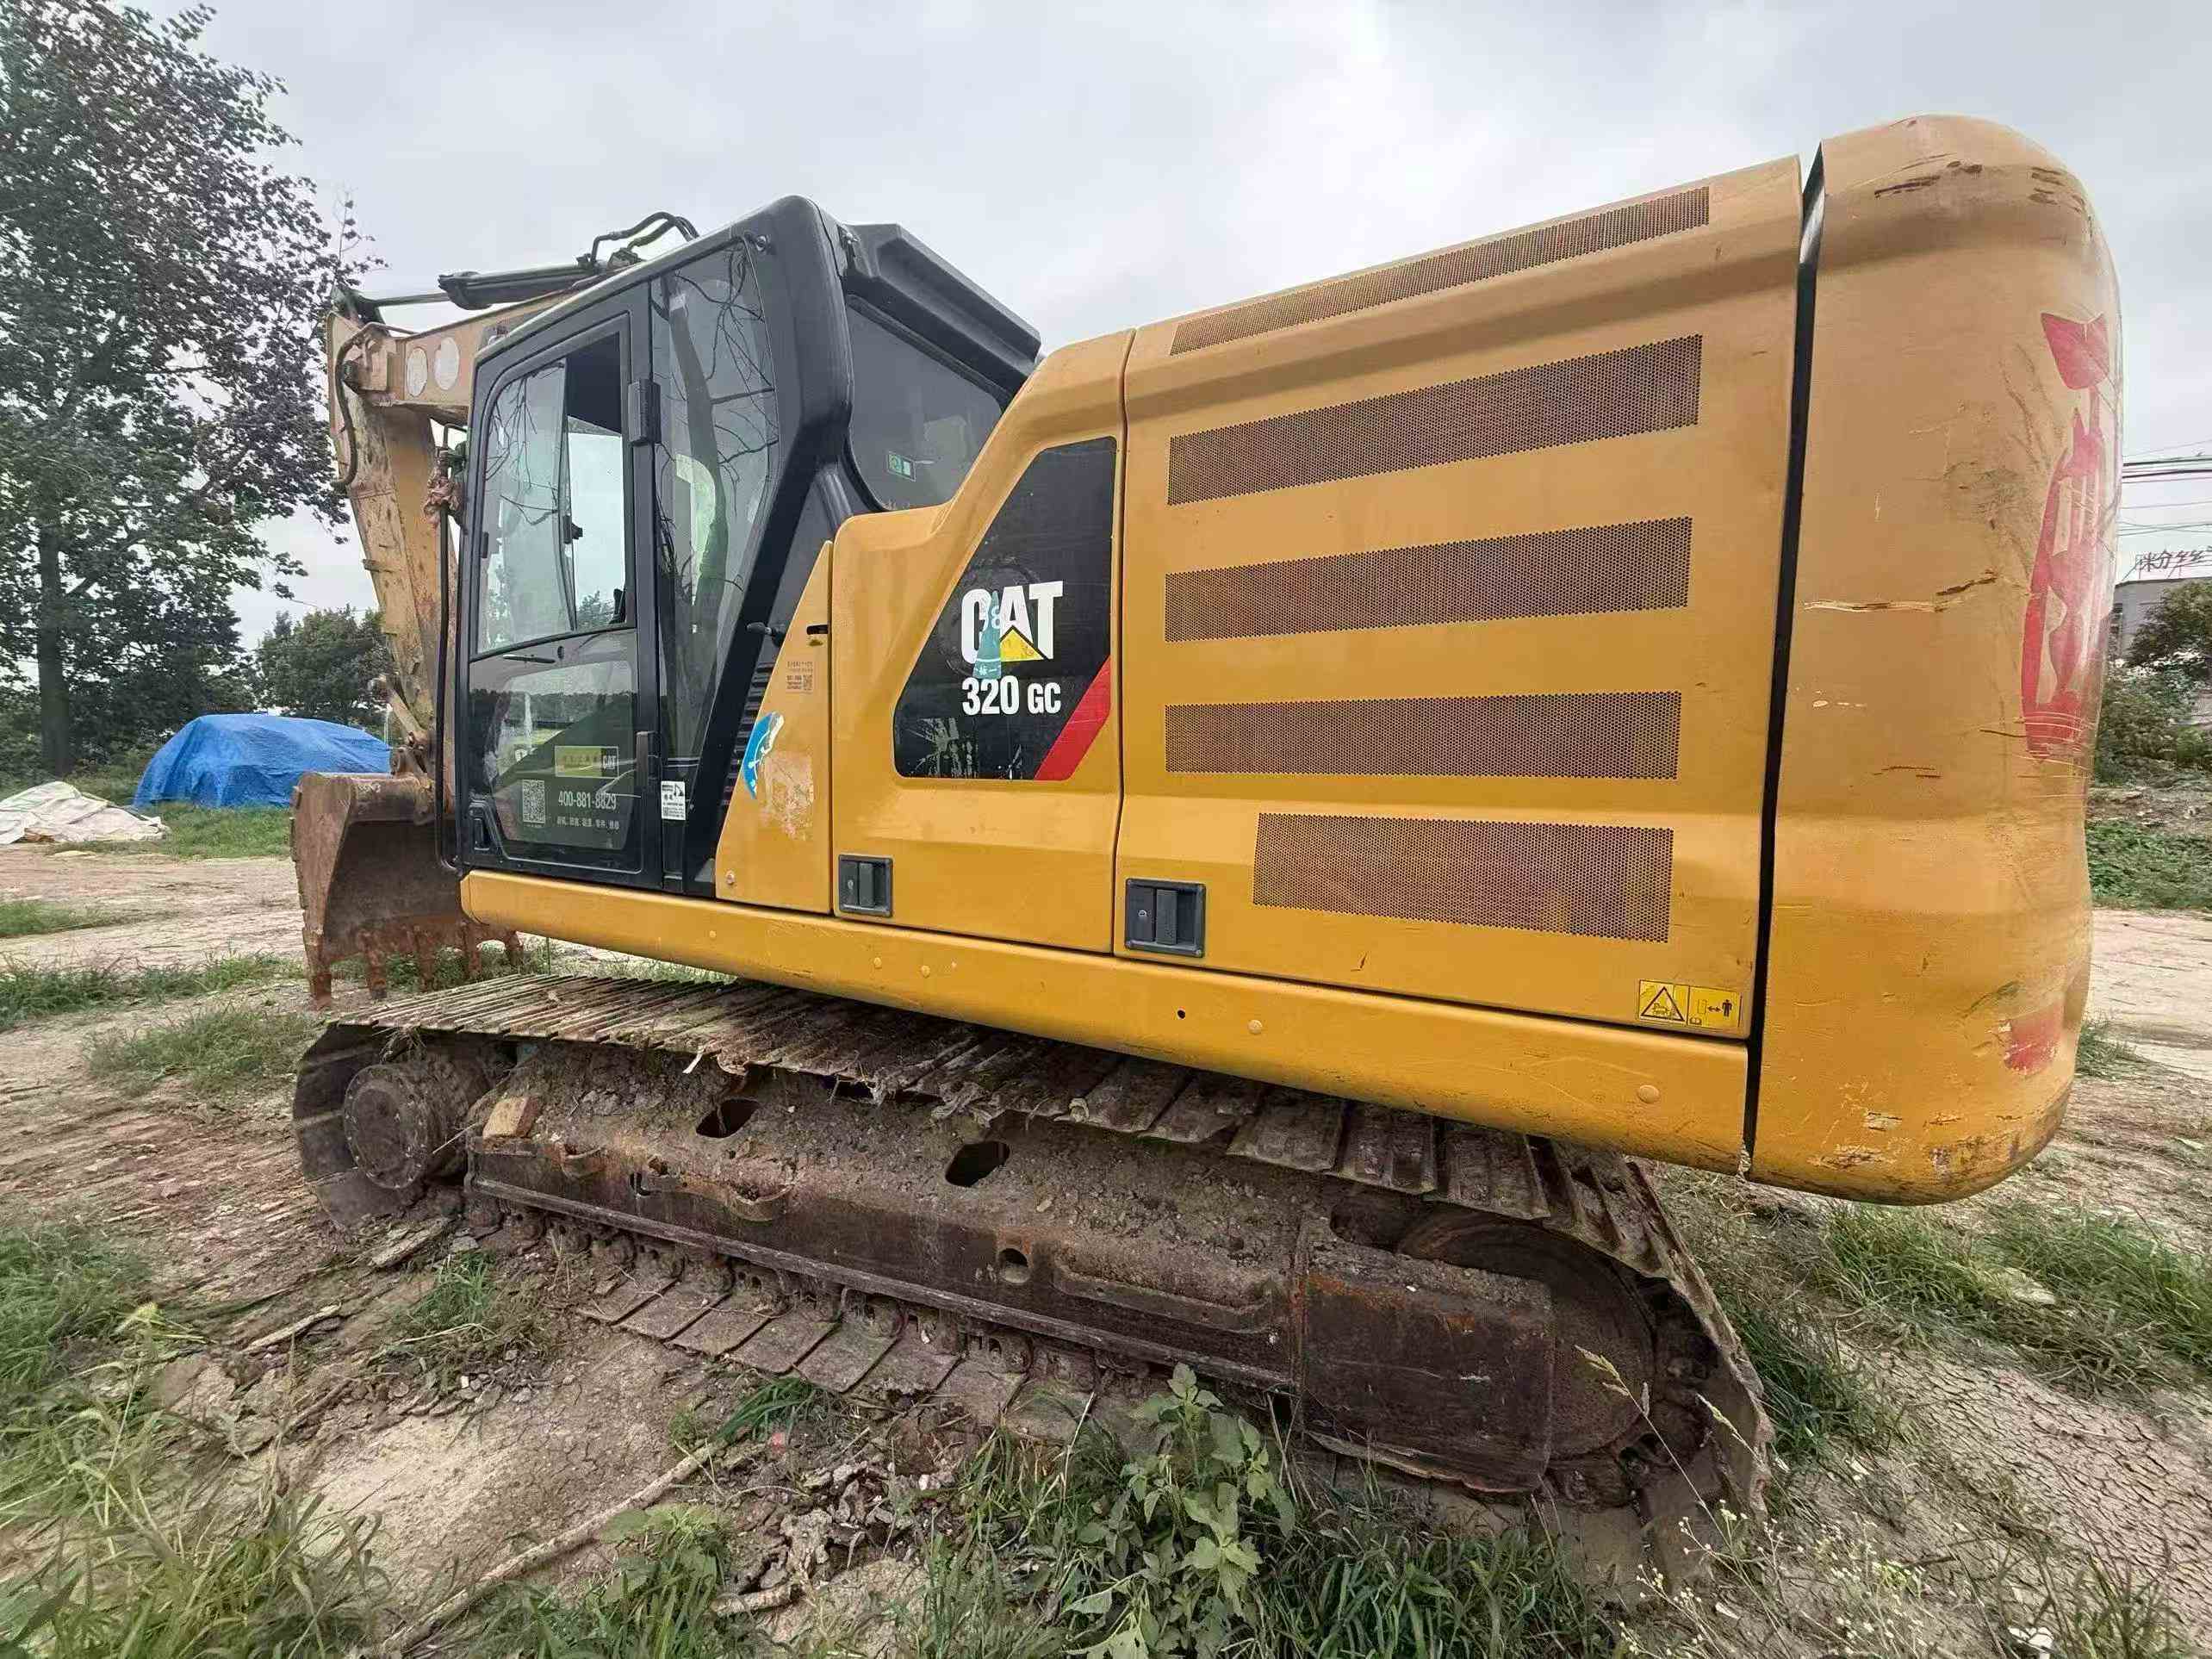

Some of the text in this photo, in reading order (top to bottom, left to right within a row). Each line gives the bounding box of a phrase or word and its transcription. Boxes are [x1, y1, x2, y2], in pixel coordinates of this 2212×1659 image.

[961, 581, 1063, 664] CAT
[962, 675, 1062, 716] 320 GC
[558, 790, 617, 811] 400-881-8829
